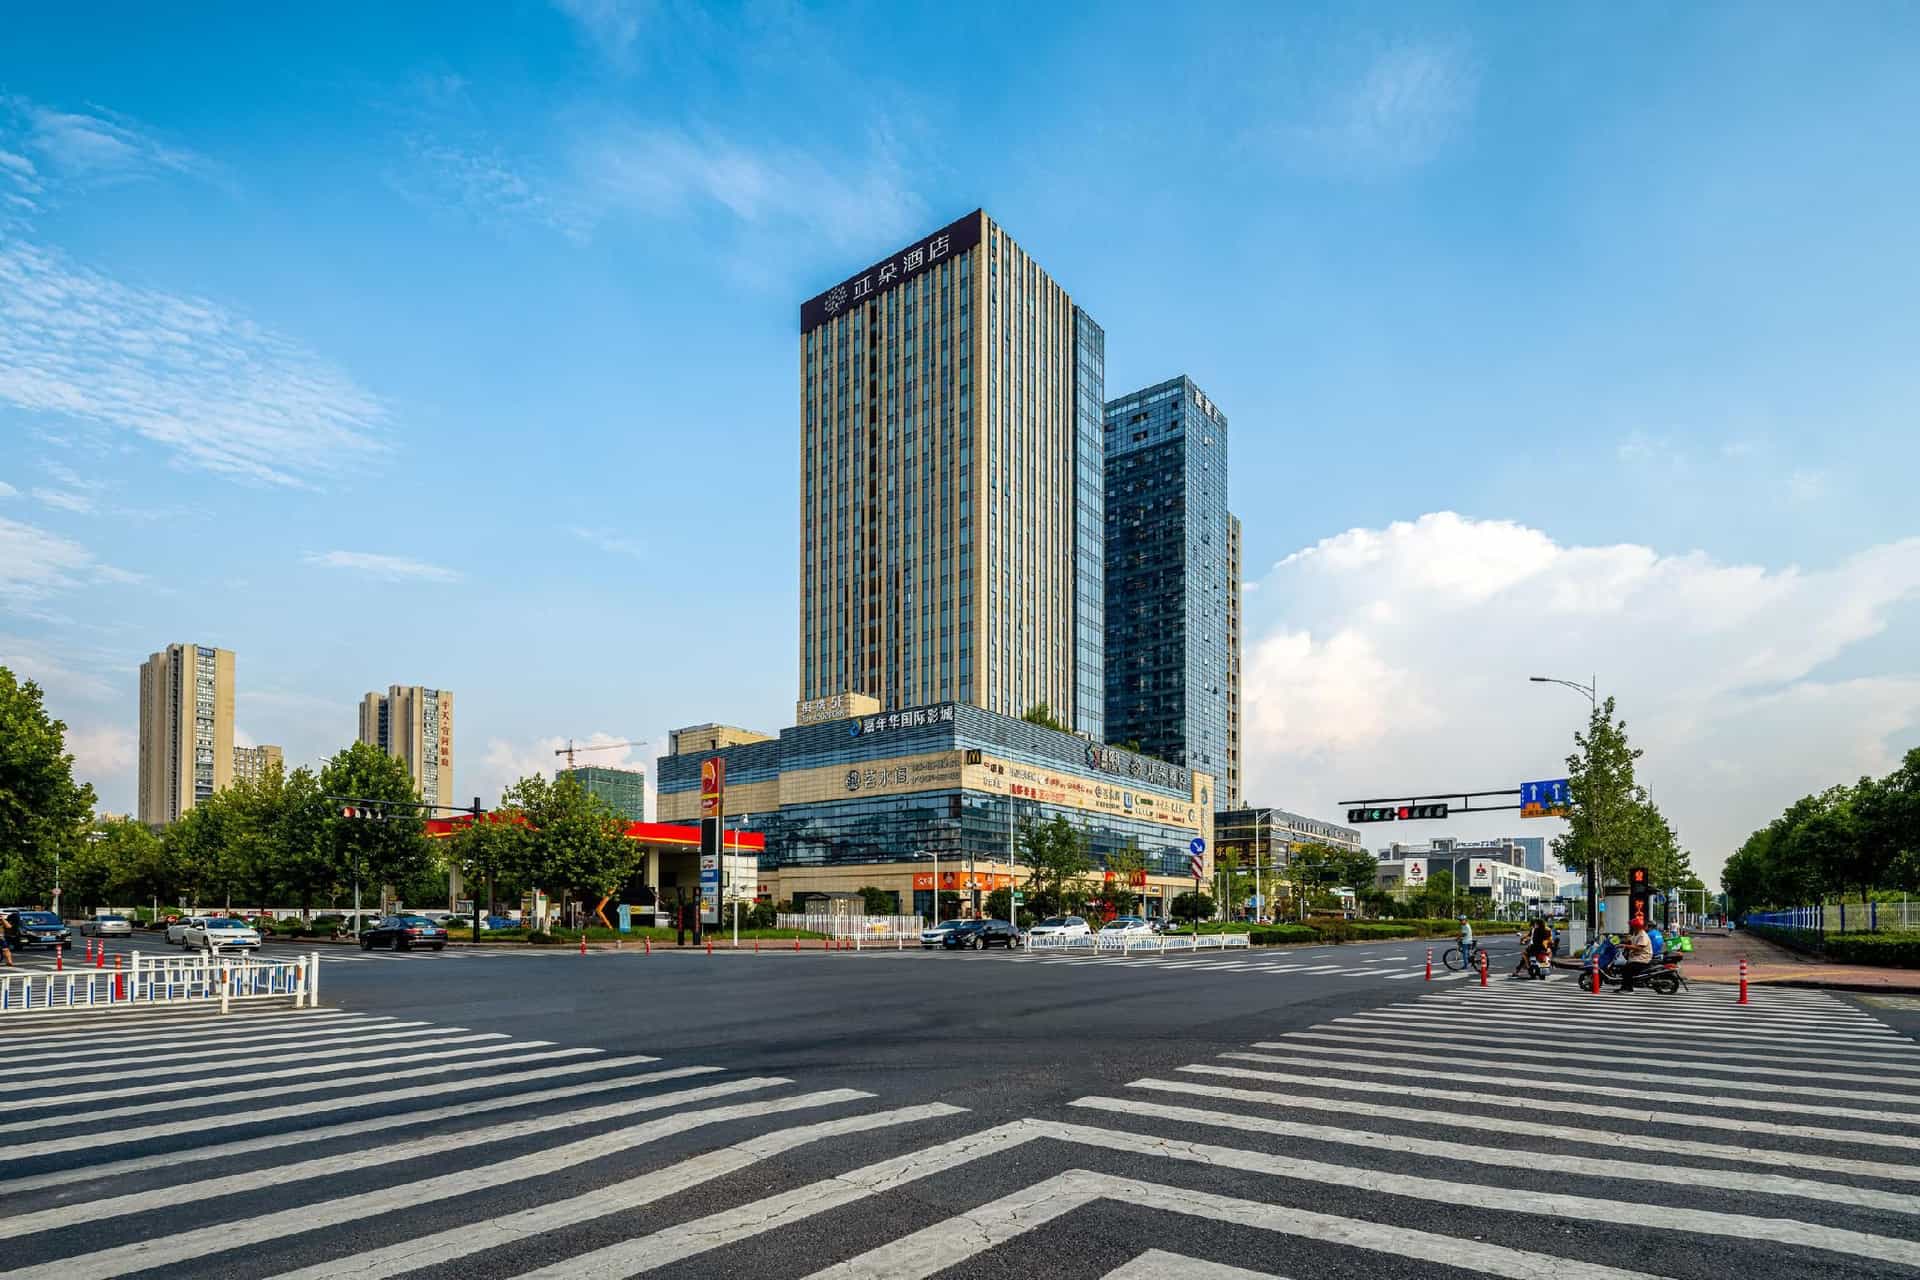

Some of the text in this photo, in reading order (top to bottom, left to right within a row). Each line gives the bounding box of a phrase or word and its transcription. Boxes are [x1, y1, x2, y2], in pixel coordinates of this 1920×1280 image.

[853, 234, 950, 301] 亚朵酒店
[863, 705, 954, 733] 嘉年华国际影城
